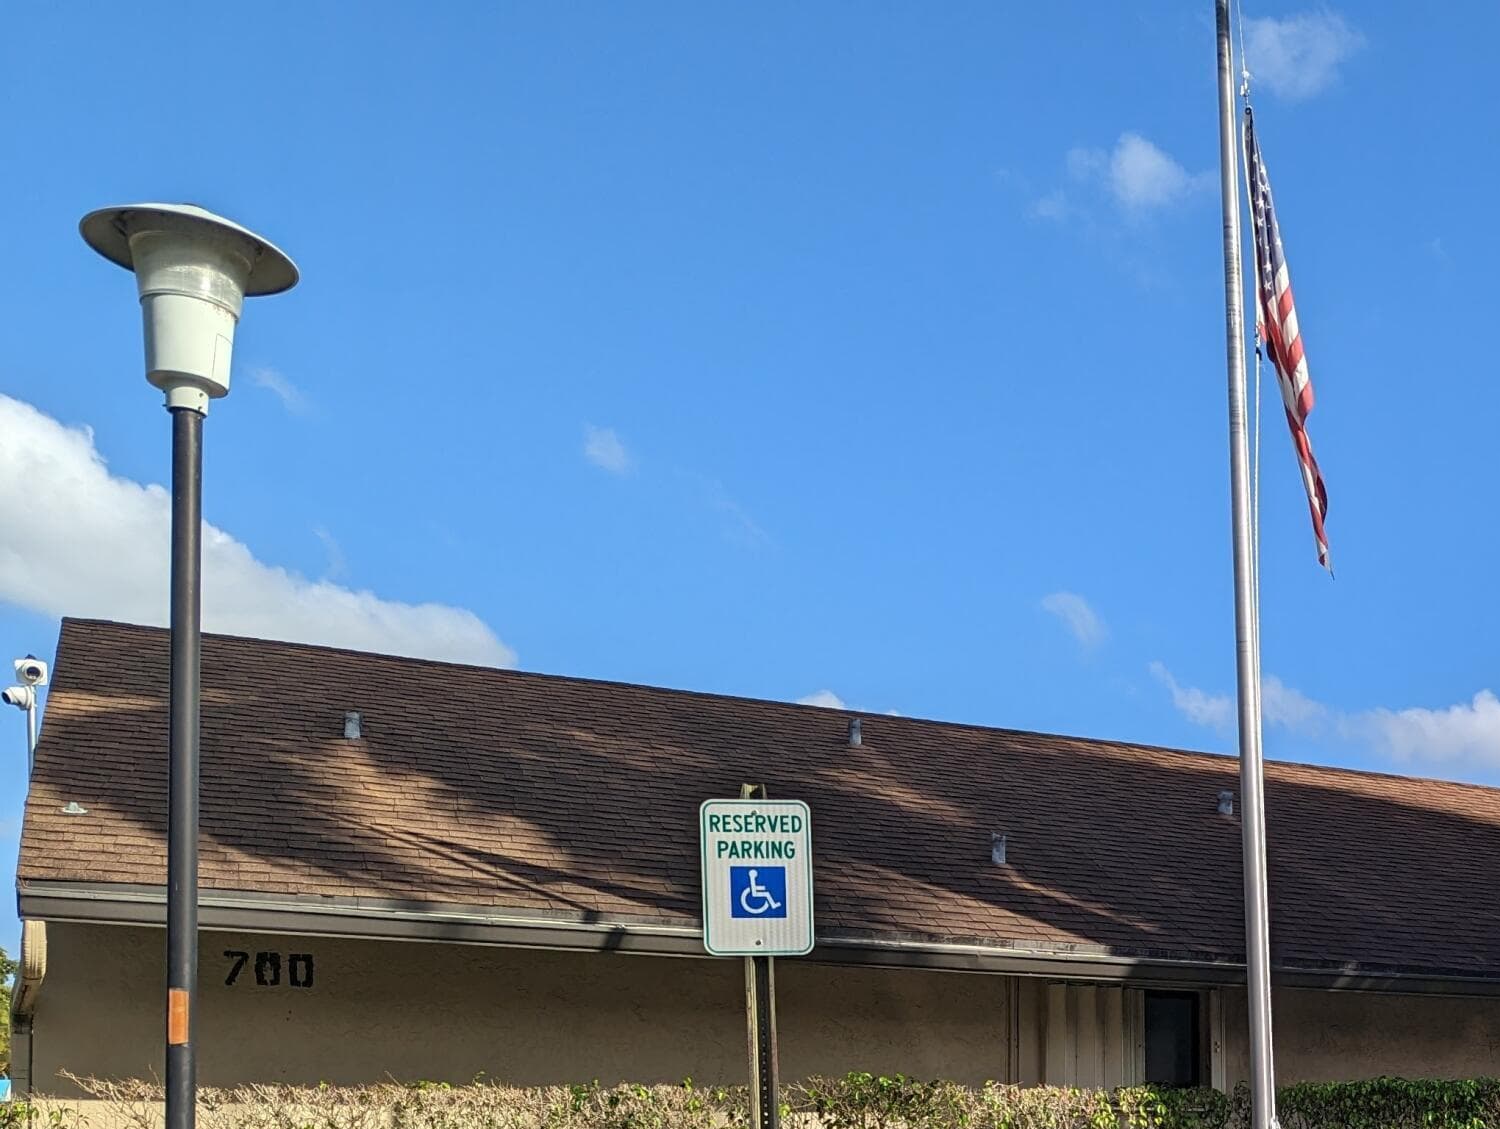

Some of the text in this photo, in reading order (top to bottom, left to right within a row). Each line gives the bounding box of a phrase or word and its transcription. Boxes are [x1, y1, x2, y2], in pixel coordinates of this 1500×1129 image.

[709, 815, 802, 833] RESERVED
[717, 841, 795, 859] PARKING
[224, 951, 314, 988] 700
